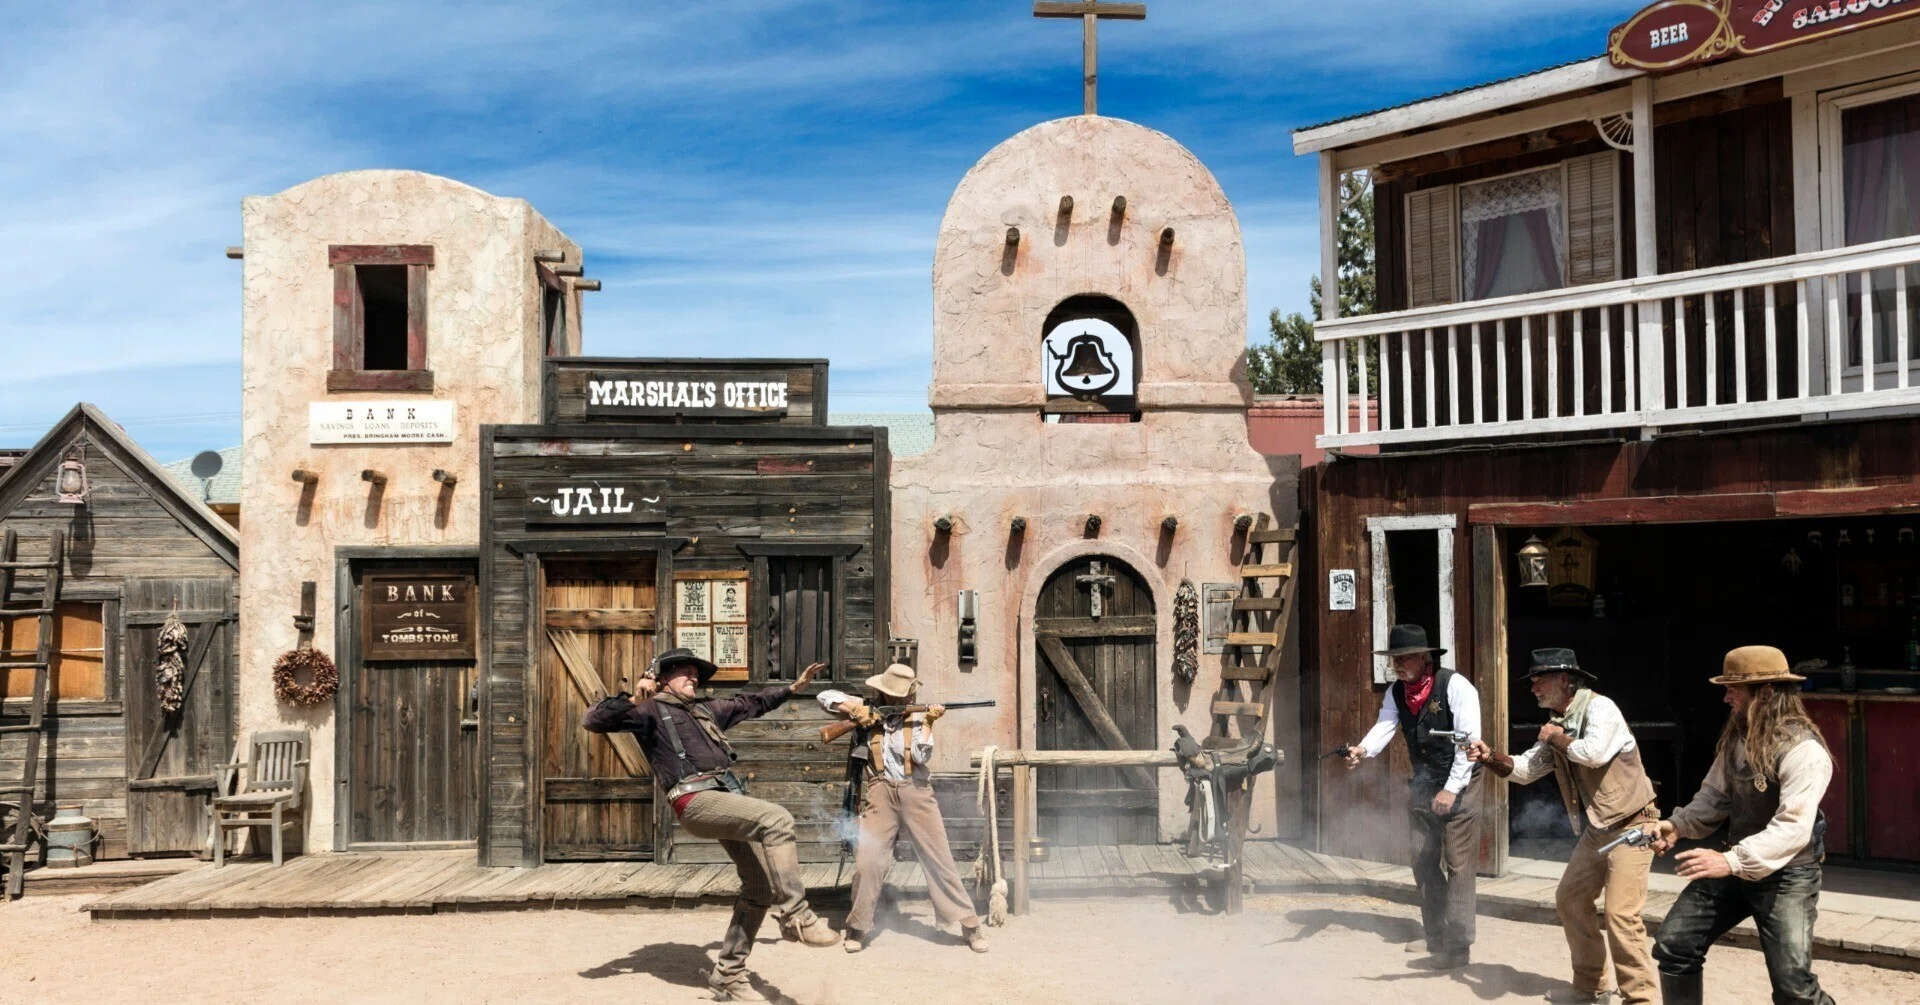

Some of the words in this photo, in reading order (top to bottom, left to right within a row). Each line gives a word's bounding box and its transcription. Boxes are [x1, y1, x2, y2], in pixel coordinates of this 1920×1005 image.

[1792, 0, 1908, 29] SALO
[1649, 22, 1689, 49] BEER
[589, 380, 716, 408] MARSHAL'S
[724, 382, 788, 408] OFFICE
[346, 408, 416, 420] BANK
[320, 422, 354, 430] SAVINGS
[364, 422, 391, 430] LOANS
[400, 421, 439, 429] DEPOSITS
[552, 487, 633, 516] JAIL
[387, 585, 455, 601] BANK
[413, 609, 423, 617] of
[715, 626, 745, 635] WANTED
[382, 634, 459, 643] TOMBSTONE
